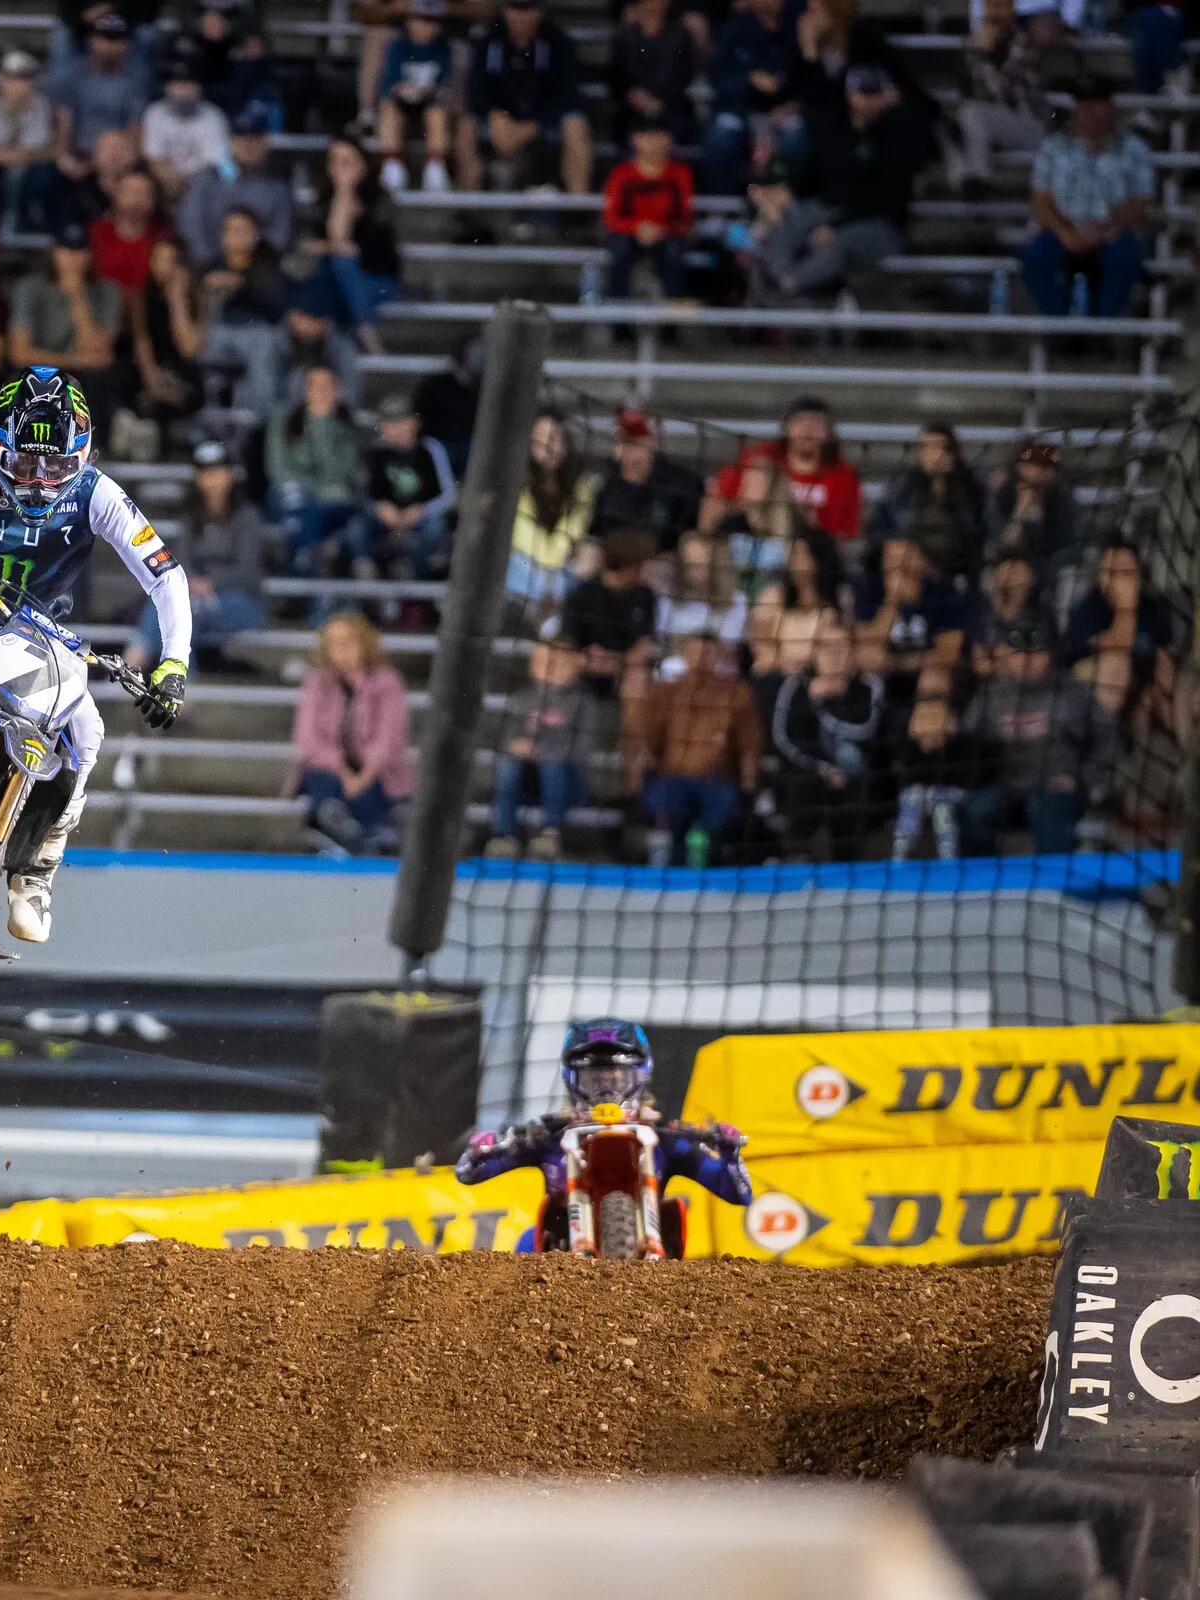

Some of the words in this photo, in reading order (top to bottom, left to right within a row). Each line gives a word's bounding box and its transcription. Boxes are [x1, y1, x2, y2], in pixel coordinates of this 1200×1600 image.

[20, 443, 60, 453] MONSTER
[882, 1056, 1200, 1113] DUNL
[1068, 1265, 1118, 1425] OAKLEY
